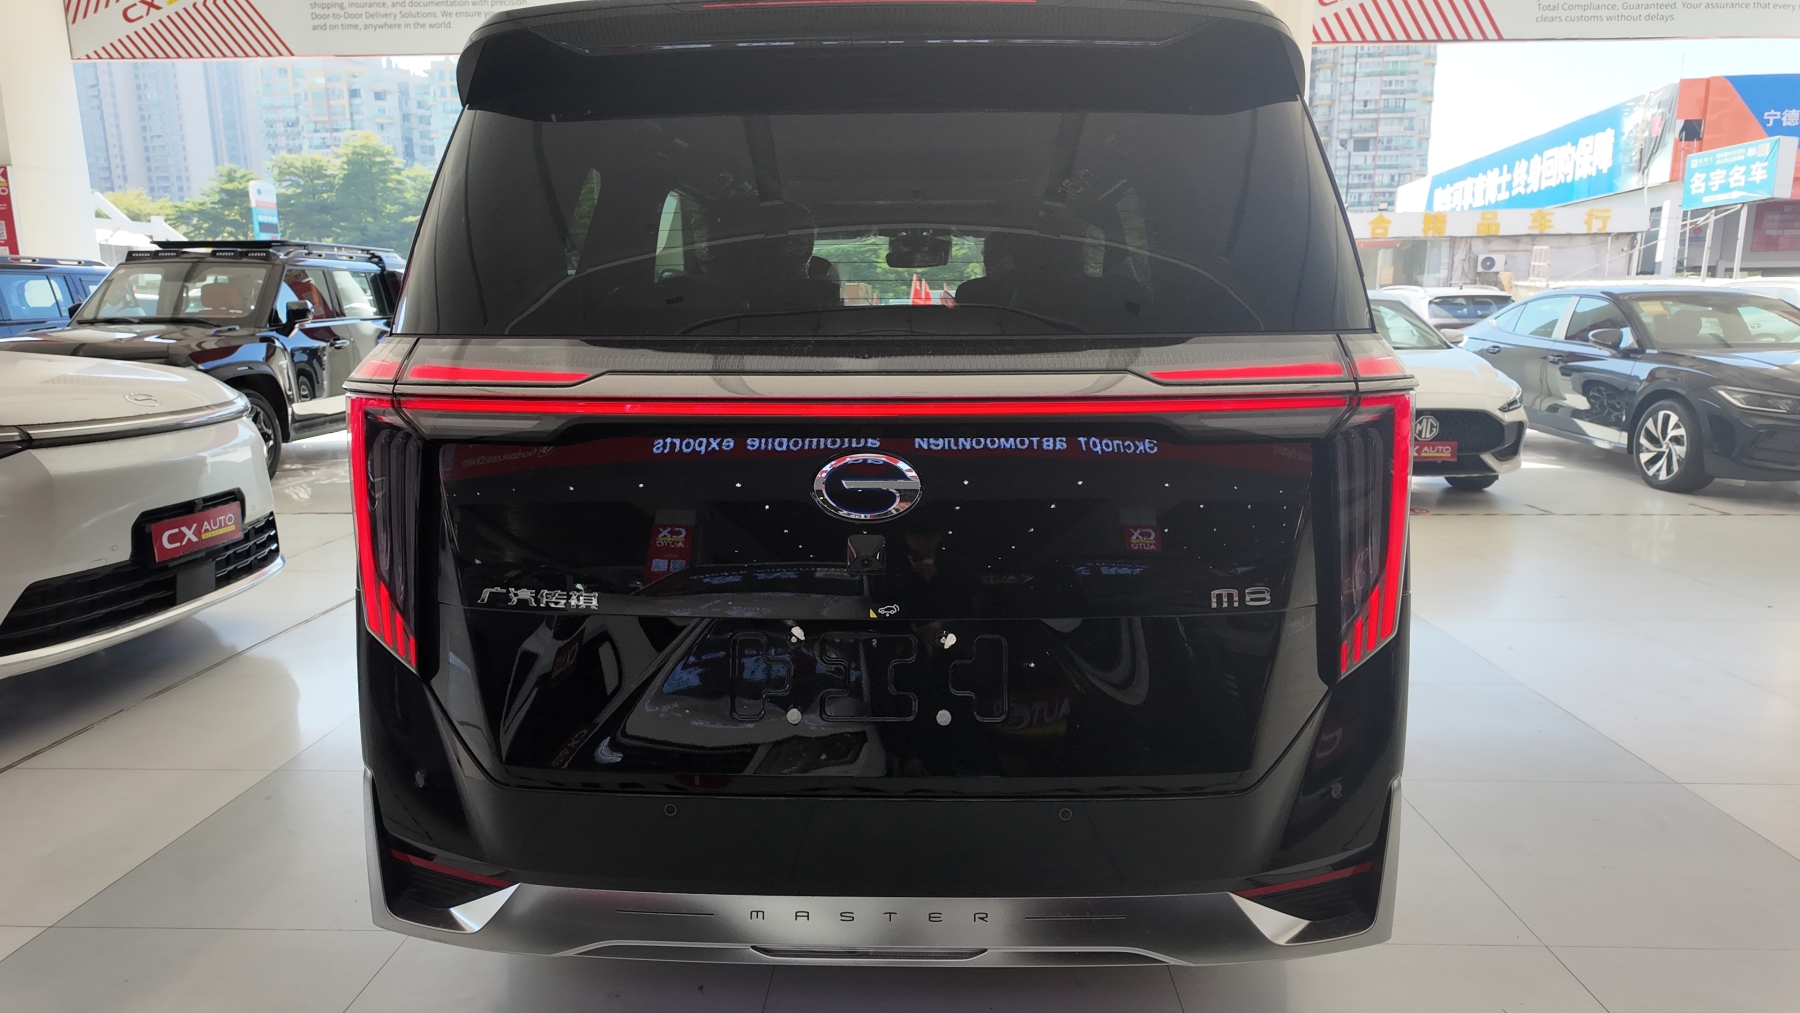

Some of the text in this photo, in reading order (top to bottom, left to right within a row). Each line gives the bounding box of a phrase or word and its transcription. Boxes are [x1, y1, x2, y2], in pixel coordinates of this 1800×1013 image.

[310, 1, 347, 11] shipping,
[348, 0, 389, 9] insurance,
[390, 0, 406, 8] and
[407, 0, 469, 8] documentation
[490, 0, 529, 8] precision.
[1537, 3, 1559, 11] Total
[1561, 2, 1619, 12] Compliance,
[1621, 2, 1679, 10] Guaranteed.
[1681, 1, 1702, 9] Your
[1752, 1, 1770, 9] that
[1772, 3, 1796, 12] every
[310, 11, 363, 20] Door-to-Door
[365, 11, 397, 21] Delivery
[399, 10, 439, 19] Solutions.
[440, 10, 451, 18] We
[1535, 13, 1677, 23] clears customs without delays.
[311, 21, 453, 32] and on time, anywhere in the world.
[1690, 161, 1769, 195] 名宇名车
[1415, 417, 1438, 440] MG
[162, 523, 199, 549] CX
[202, 513, 235, 533] AUTO
[478, 586, 599, 610] 广汽传祺
[1211, 586, 1271, 608] M8
[750, 910, 989, 923] MASTER
